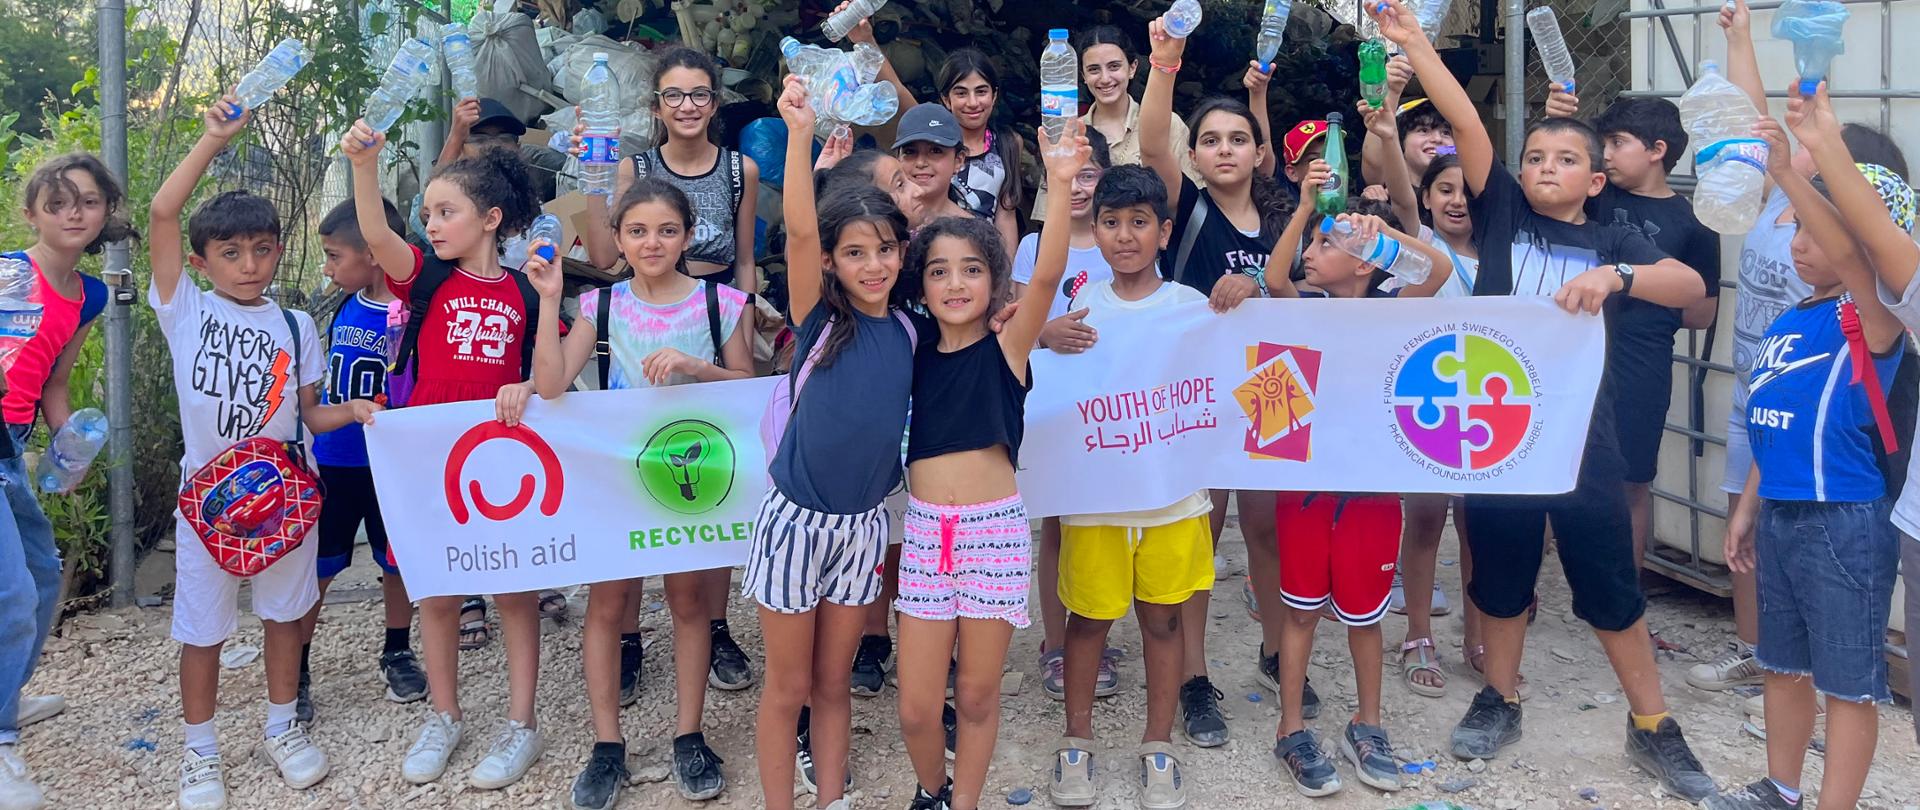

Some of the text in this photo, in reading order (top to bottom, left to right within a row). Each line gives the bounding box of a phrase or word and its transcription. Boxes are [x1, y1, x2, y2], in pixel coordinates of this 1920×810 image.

[443, 297, 522, 326] I WILL CHANGE
[446, 320, 515, 344] The future
[456, 310, 508, 358] 73
[192, 345, 264, 407] GIVE
[326, 352, 388, 404] 10
[1384, 354, 1404, 404] FUNDACJA
[1403, 326, 1443, 352] FENICJA
[1462, 322, 1515, 348] ŚWIĘTEGO
[1513, 346, 1543, 398] CHARBELA
[217, 401, 253, 441] UP
[1077, 377, 1217, 424] YOUTH OF HOPE
[1750, 406, 1795, 430] JUST
[1085, 408, 1217, 454] شباب الرجاء
[1389, 423, 1425, 468] PHOENICIA
[1426, 464, 1491, 481] FOUNDATION
[1491, 465, 1505, 478] OF
[1518, 419, 1544, 460] CHARBEL
[446, 533, 577, 572] Polish aid
